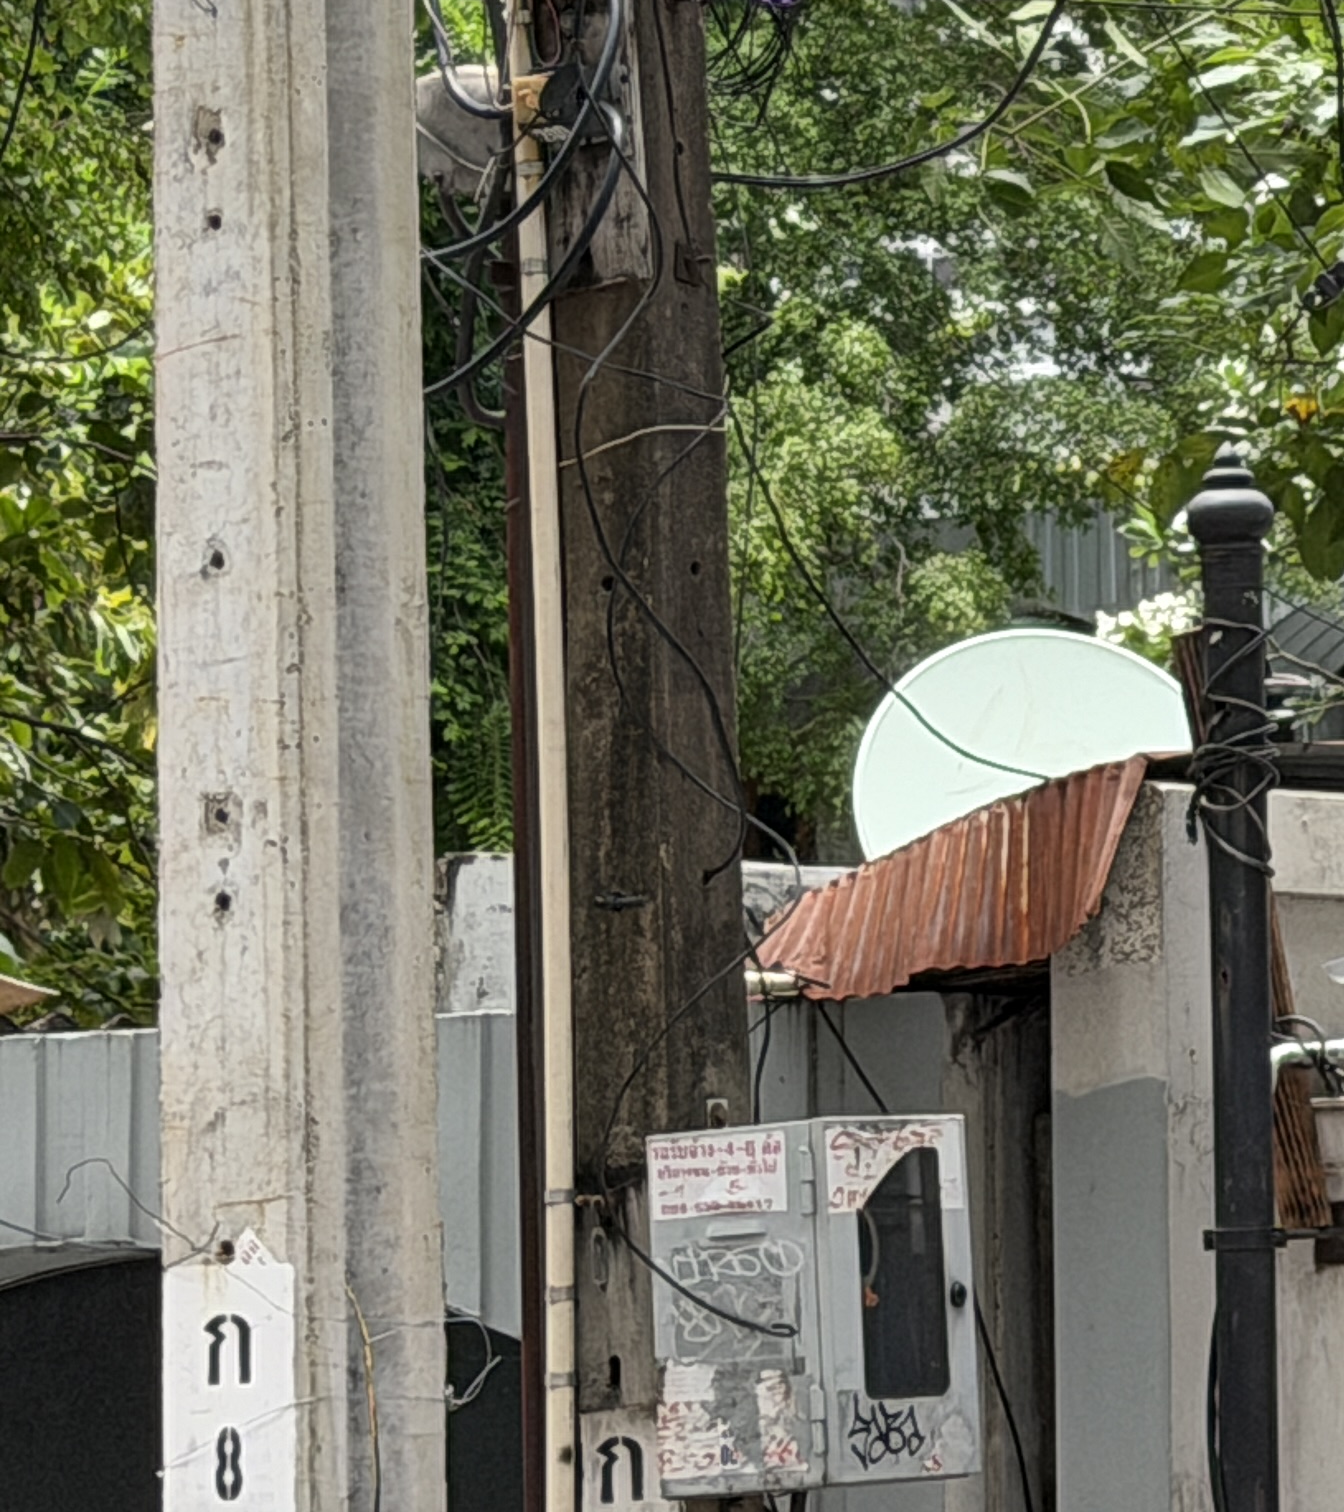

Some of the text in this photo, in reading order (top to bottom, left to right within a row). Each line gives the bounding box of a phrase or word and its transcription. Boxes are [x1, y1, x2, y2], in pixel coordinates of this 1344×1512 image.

[203, 1314, 252, 1386] ก
[215, 1426, 243, 1502] 8
[596, 1435, 644, 1505] ก
